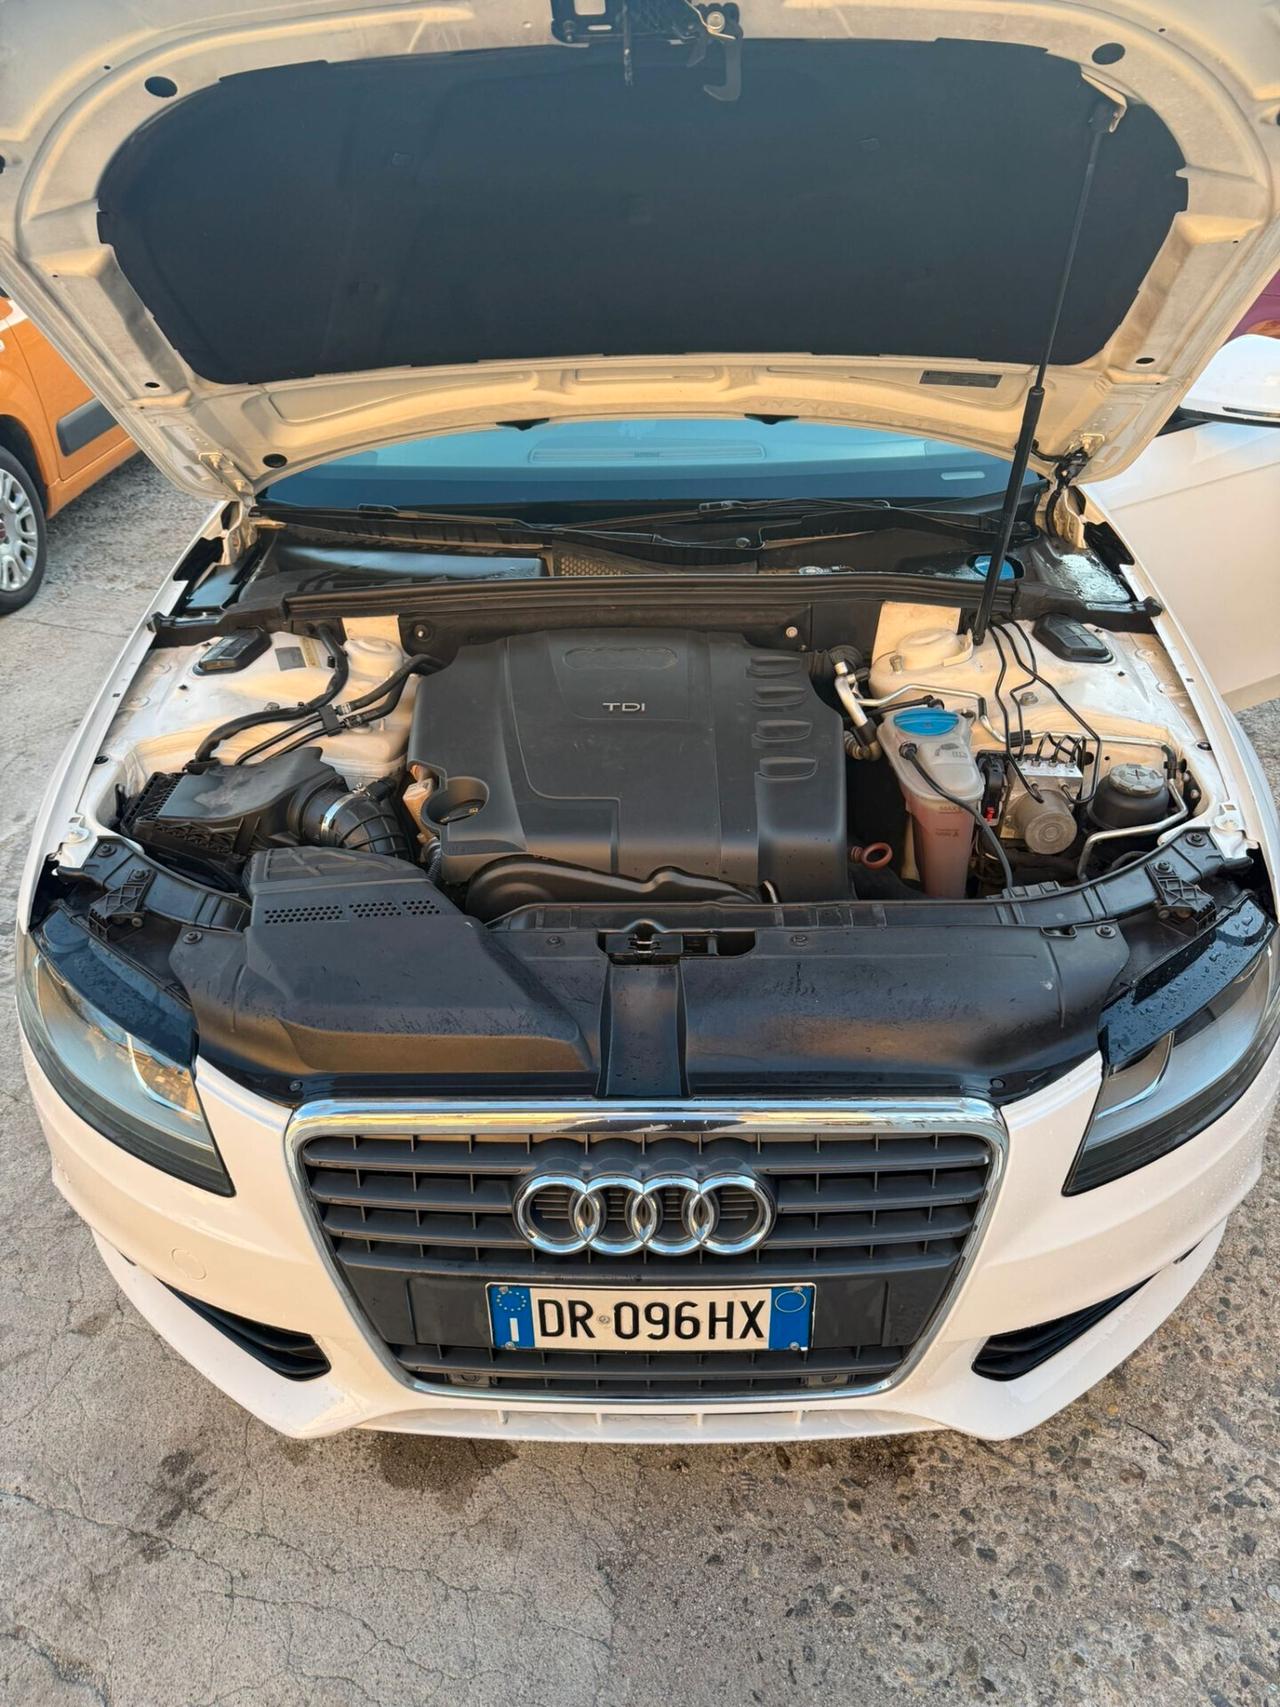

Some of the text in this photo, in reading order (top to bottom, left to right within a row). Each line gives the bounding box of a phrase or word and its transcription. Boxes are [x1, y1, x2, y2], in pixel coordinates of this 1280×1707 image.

[602, 702, 646, 712] TDI
[509, 1317, 520, 1342] I
[537, 1299, 767, 1340] DR 096HX
